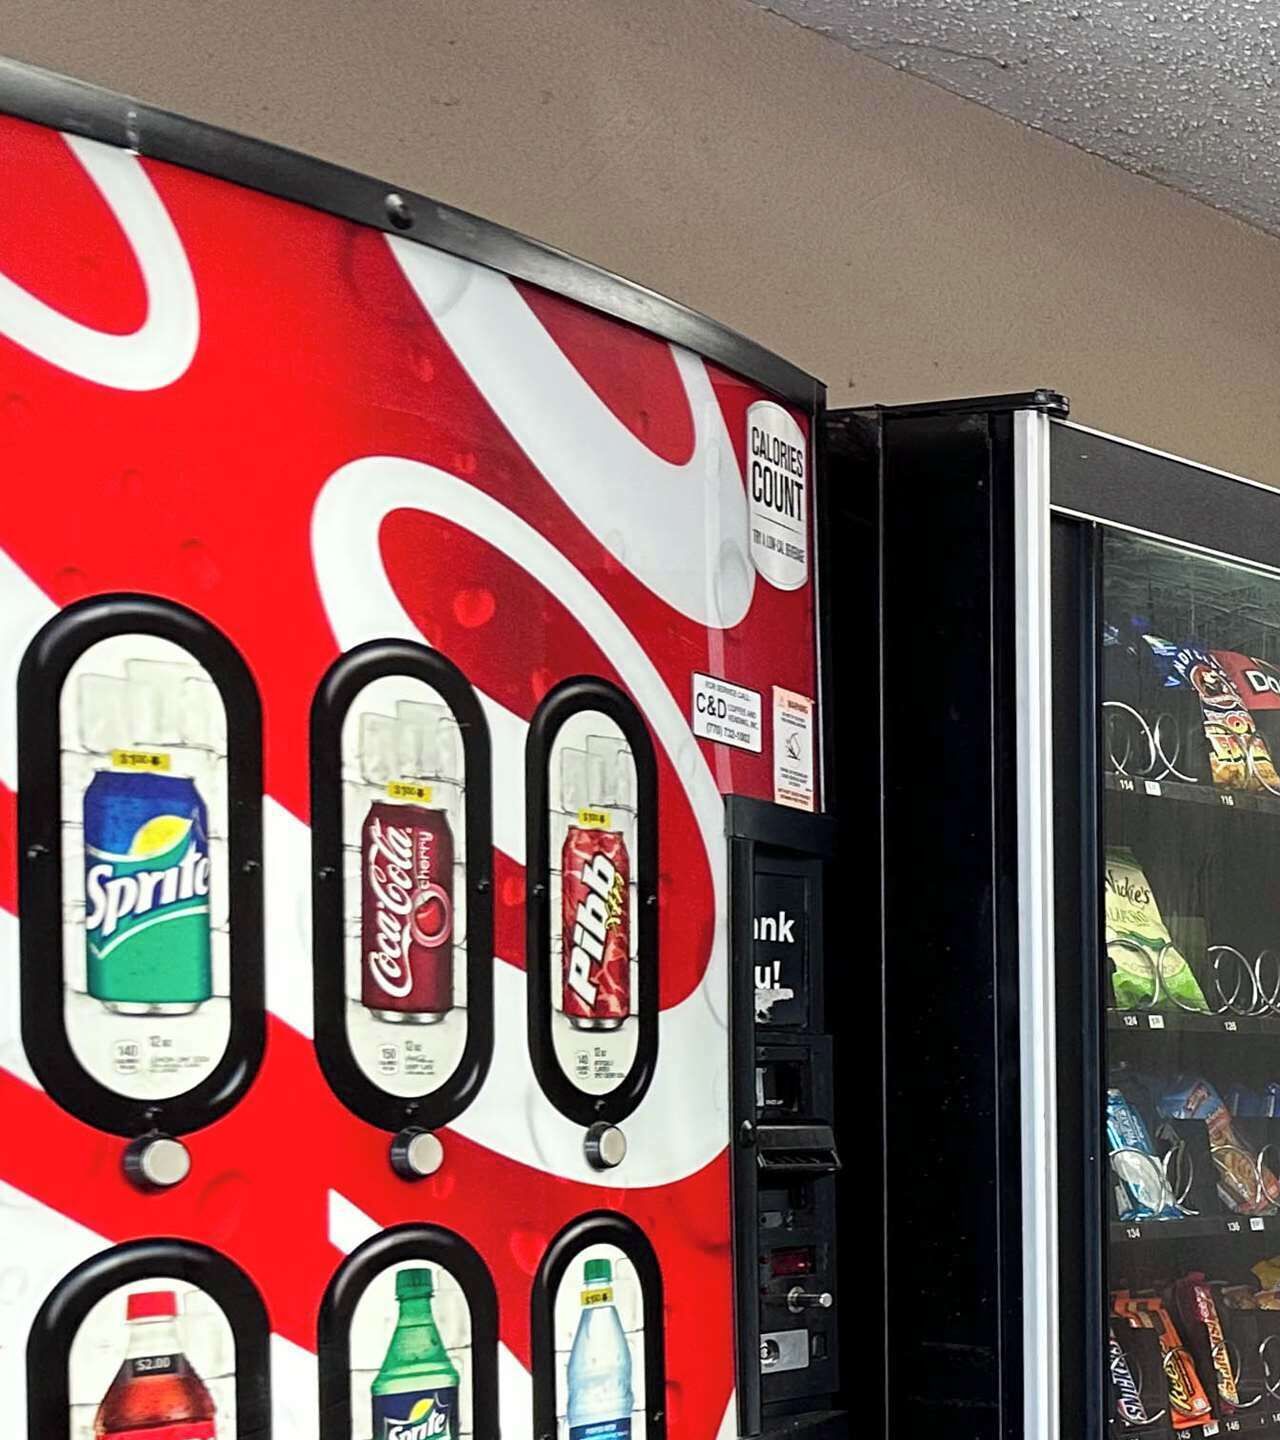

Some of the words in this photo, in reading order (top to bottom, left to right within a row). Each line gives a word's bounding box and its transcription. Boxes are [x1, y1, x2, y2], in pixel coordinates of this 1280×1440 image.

[752, 426, 803, 478] CALORIES
[752, 461, 803, 521] COUNT
[697, 692, 727, 719] C&D
[86, 841, 210, 940] Sprite
[568, 851, 616, 1009] Pibb
[1126, 1227, 1141, 1240] 134
[136, 1357, 171, 1372] $2.00
